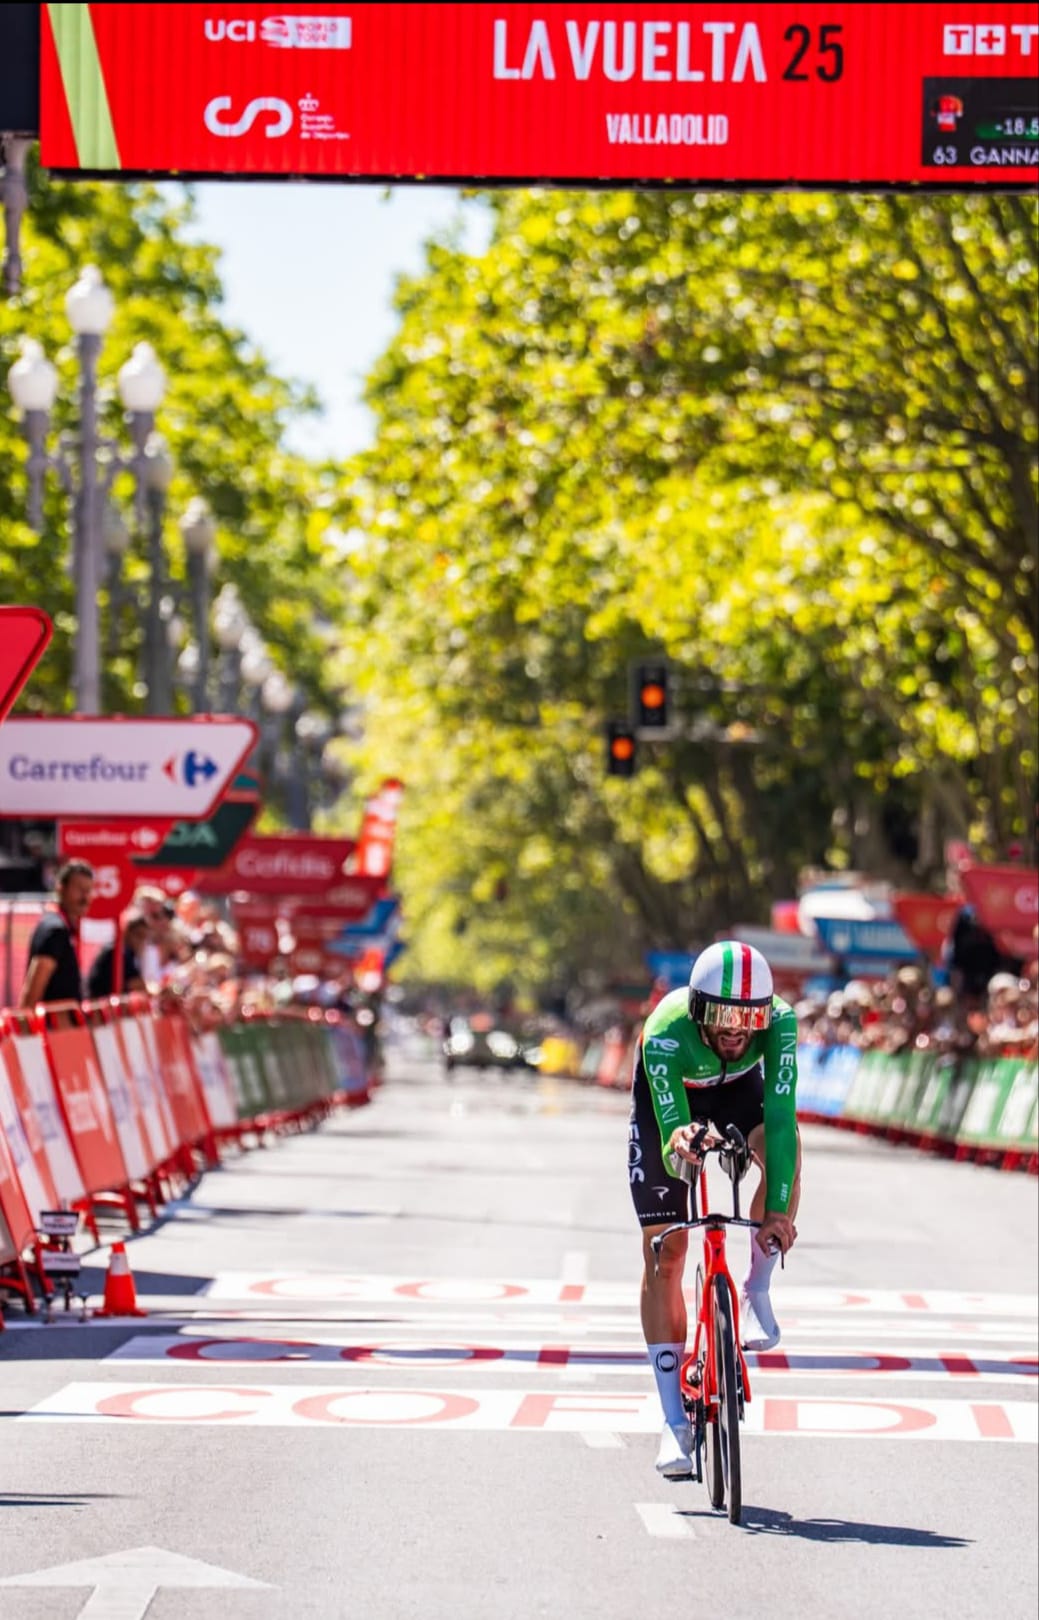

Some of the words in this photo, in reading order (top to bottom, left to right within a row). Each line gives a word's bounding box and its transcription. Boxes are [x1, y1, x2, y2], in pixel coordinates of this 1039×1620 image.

[204, 18, 256, 42] UCI
[493, 19, 556, 81] LA
[565, 19, 767, 83] VUELTA
[782, 23, 844, 83] 25
[606, 113, 729, 146] VALLADOLID
[933, 146, 958, 165] 63
[8, 754, 149, 782] Carrefour
[775, 1032, 797, 1095] INEOS
[649, 1063, 680, 1124] INEOS
